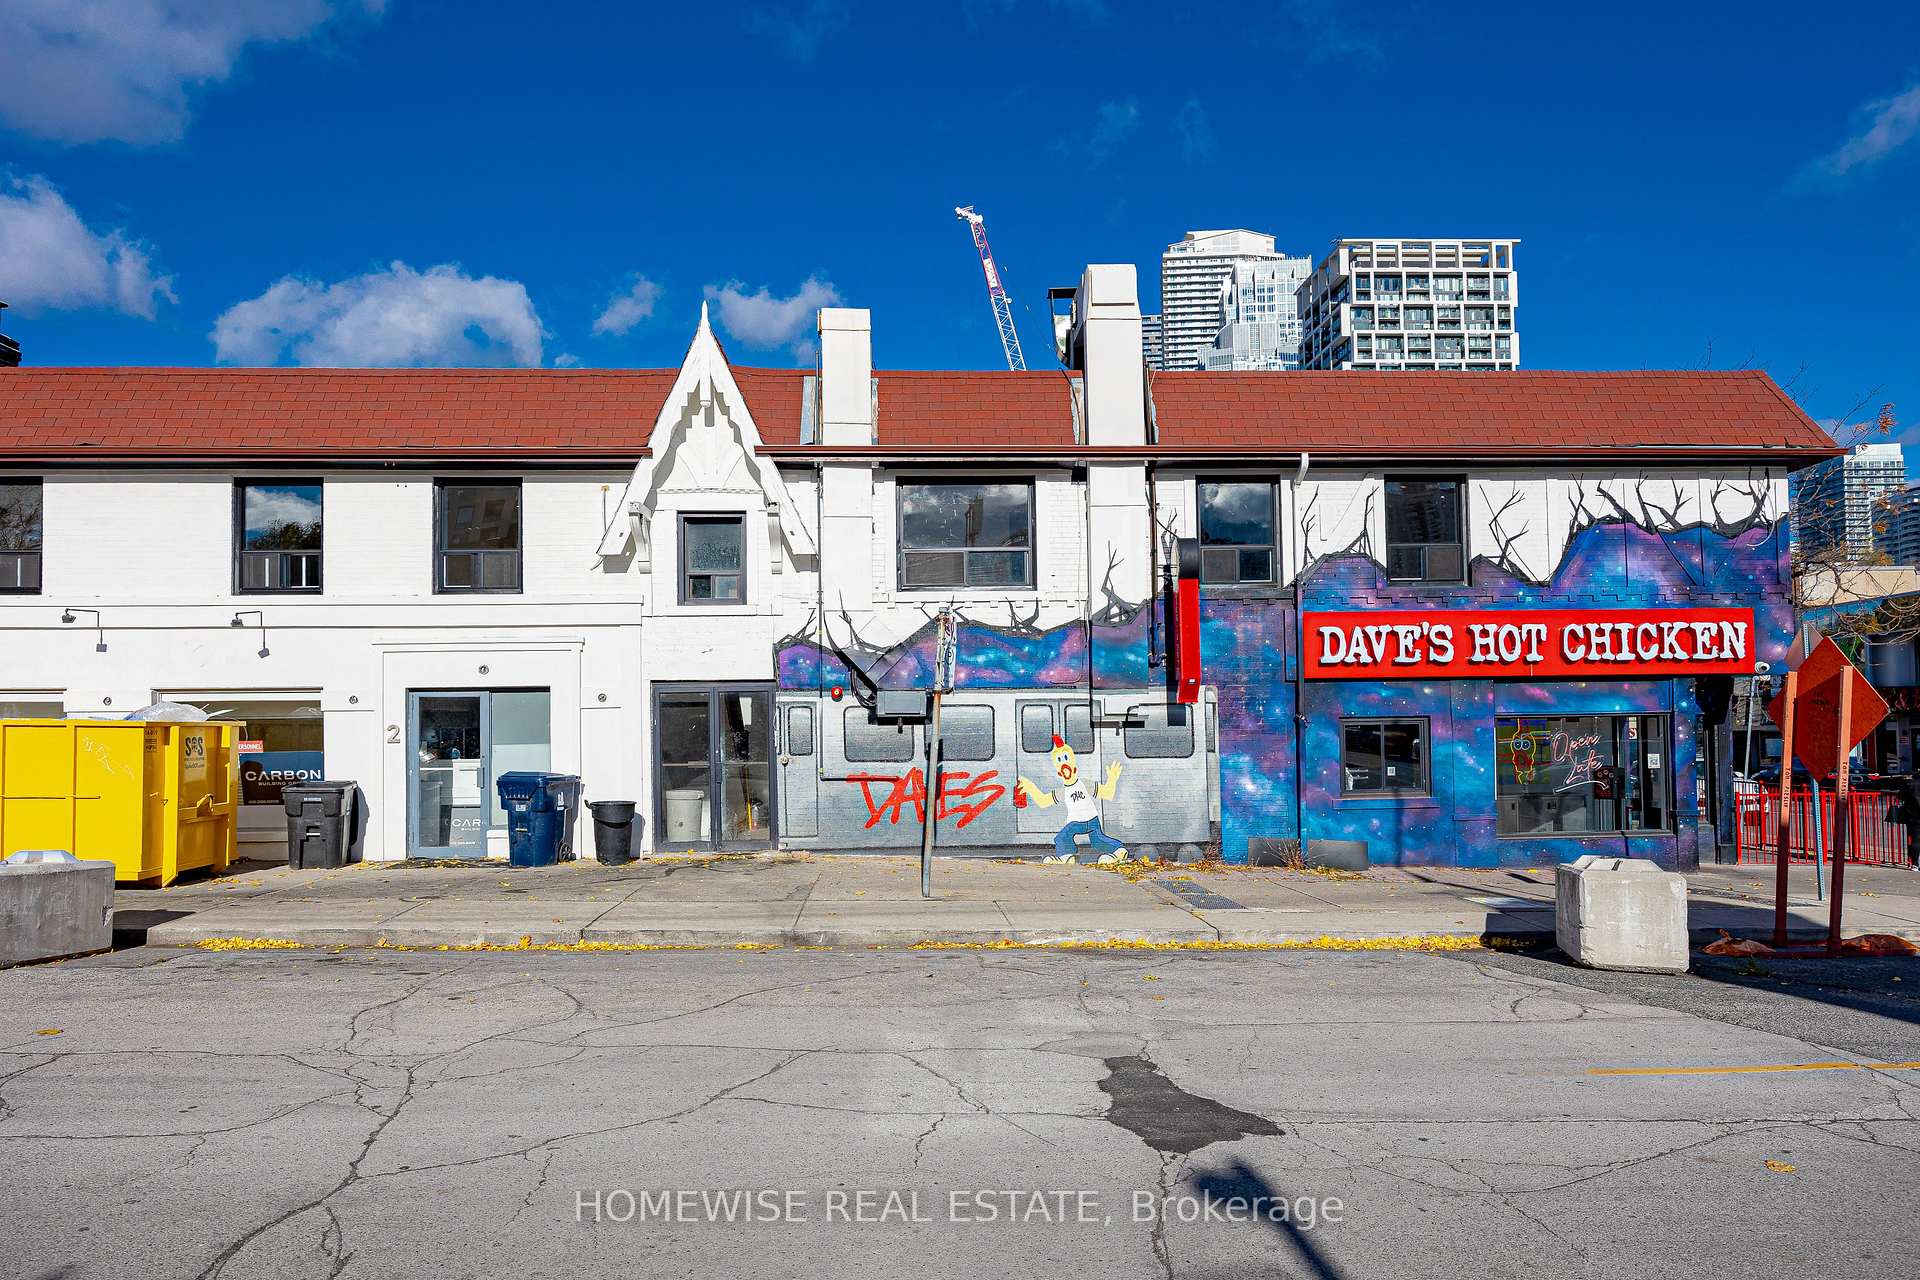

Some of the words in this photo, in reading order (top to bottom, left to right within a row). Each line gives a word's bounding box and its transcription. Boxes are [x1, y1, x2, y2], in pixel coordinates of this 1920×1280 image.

[1317, 621, 1455, 664] DAVE'S
[1466, 622, 1548, 663] HOT
[1561, 620, 1748, 662] CHICKEN
[387, 724, 401, 743] 2
[1551, 728, 1601, 762] Open
[245, 769, 321, 781] CARBON
[1563, 749, 1604, 785] Late
